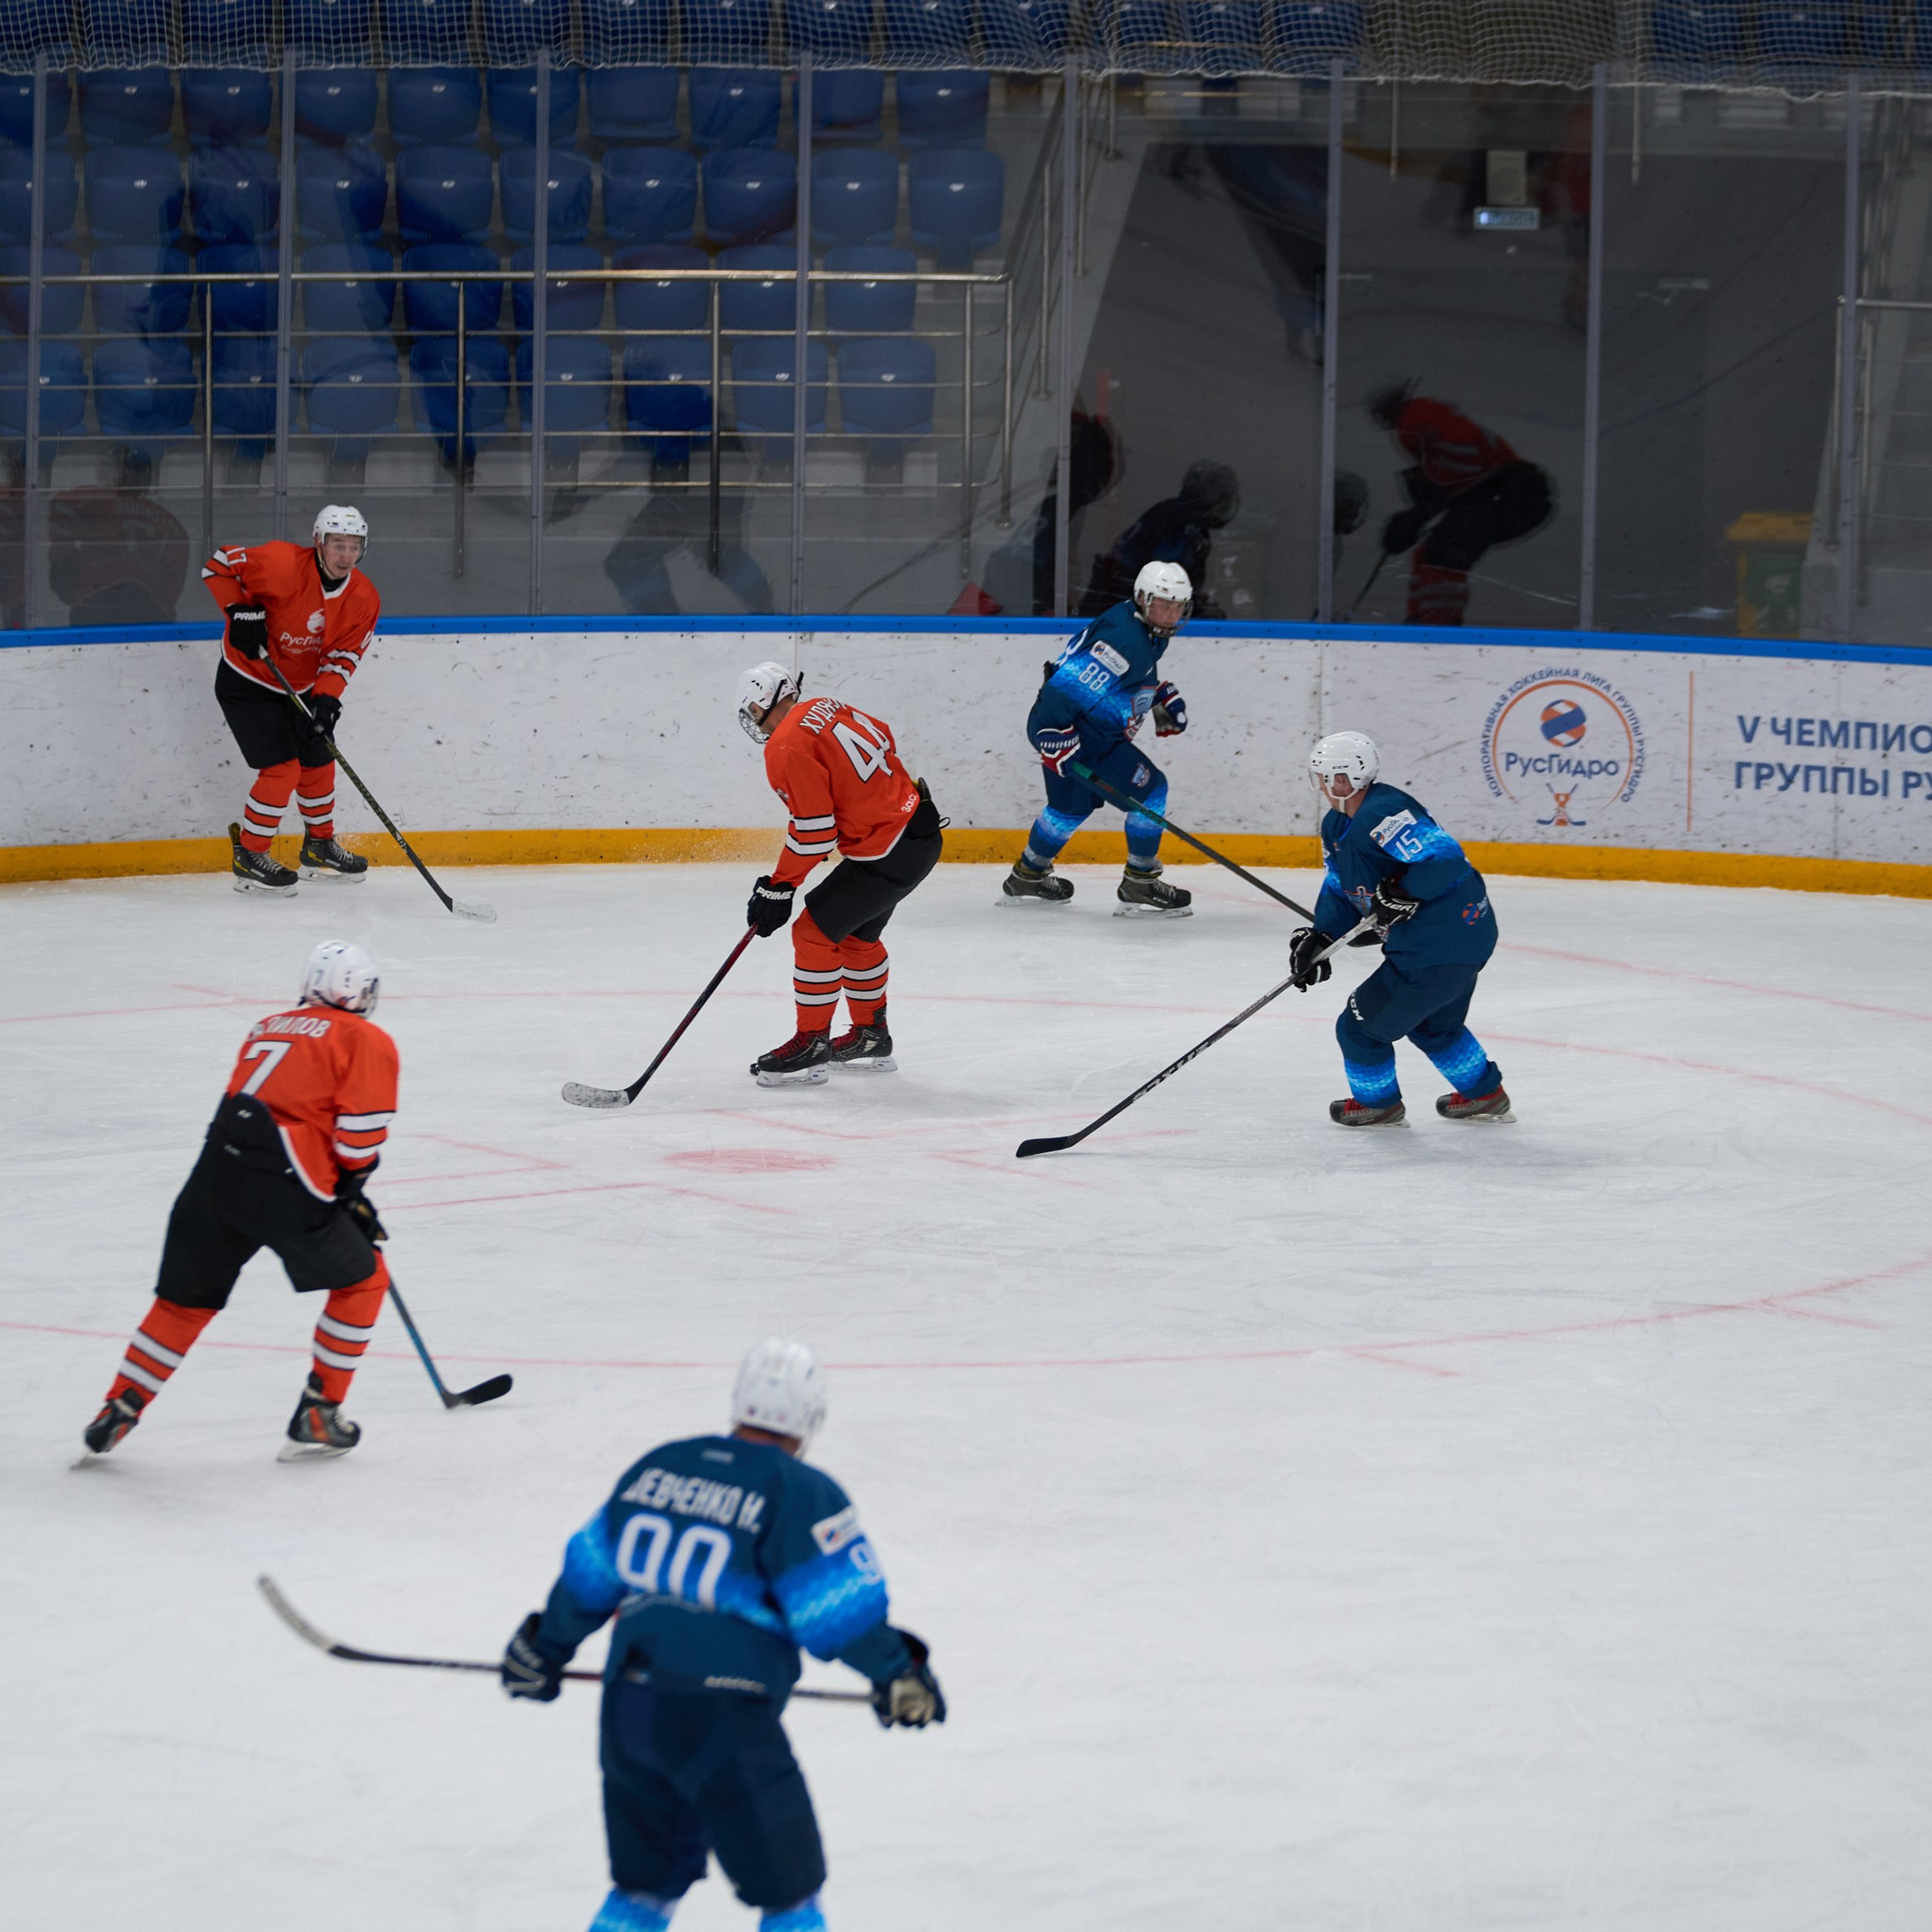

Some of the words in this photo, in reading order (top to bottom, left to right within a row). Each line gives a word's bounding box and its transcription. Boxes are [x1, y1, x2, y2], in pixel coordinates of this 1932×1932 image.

[226, 546, 248, 566] 17
[1078, 662, 1110, 691] 88
[1506, 667, 1580, 696] ХОККЕЙНАЯ
[1583, 672, 1612, 693] ЛИГА
[1611, 691, 1642, 737] ГРУППЫ
[831, 710, 893, 783] 44
[1481, 694, 1508, 798] КОРПОРАТИВНАЯ
[1737, 715, 1761, 743] V
[1770, 717, 1932, 754] ЧЕМПИО
[1505, 752, 1619, 780] РусГидро
[1620, 739, 1644, 803] РУСГИДРО
[1735, 761, 1889, 797] ГРУППЫ
[1395, 829, 1423, 861] 15
[755, 886, 793, 900] PRIME
[1152, 896, 1168, 904] CCM
[240, 1039, 294, 1095] 7
[615, 1512, 733, 1611] 90
